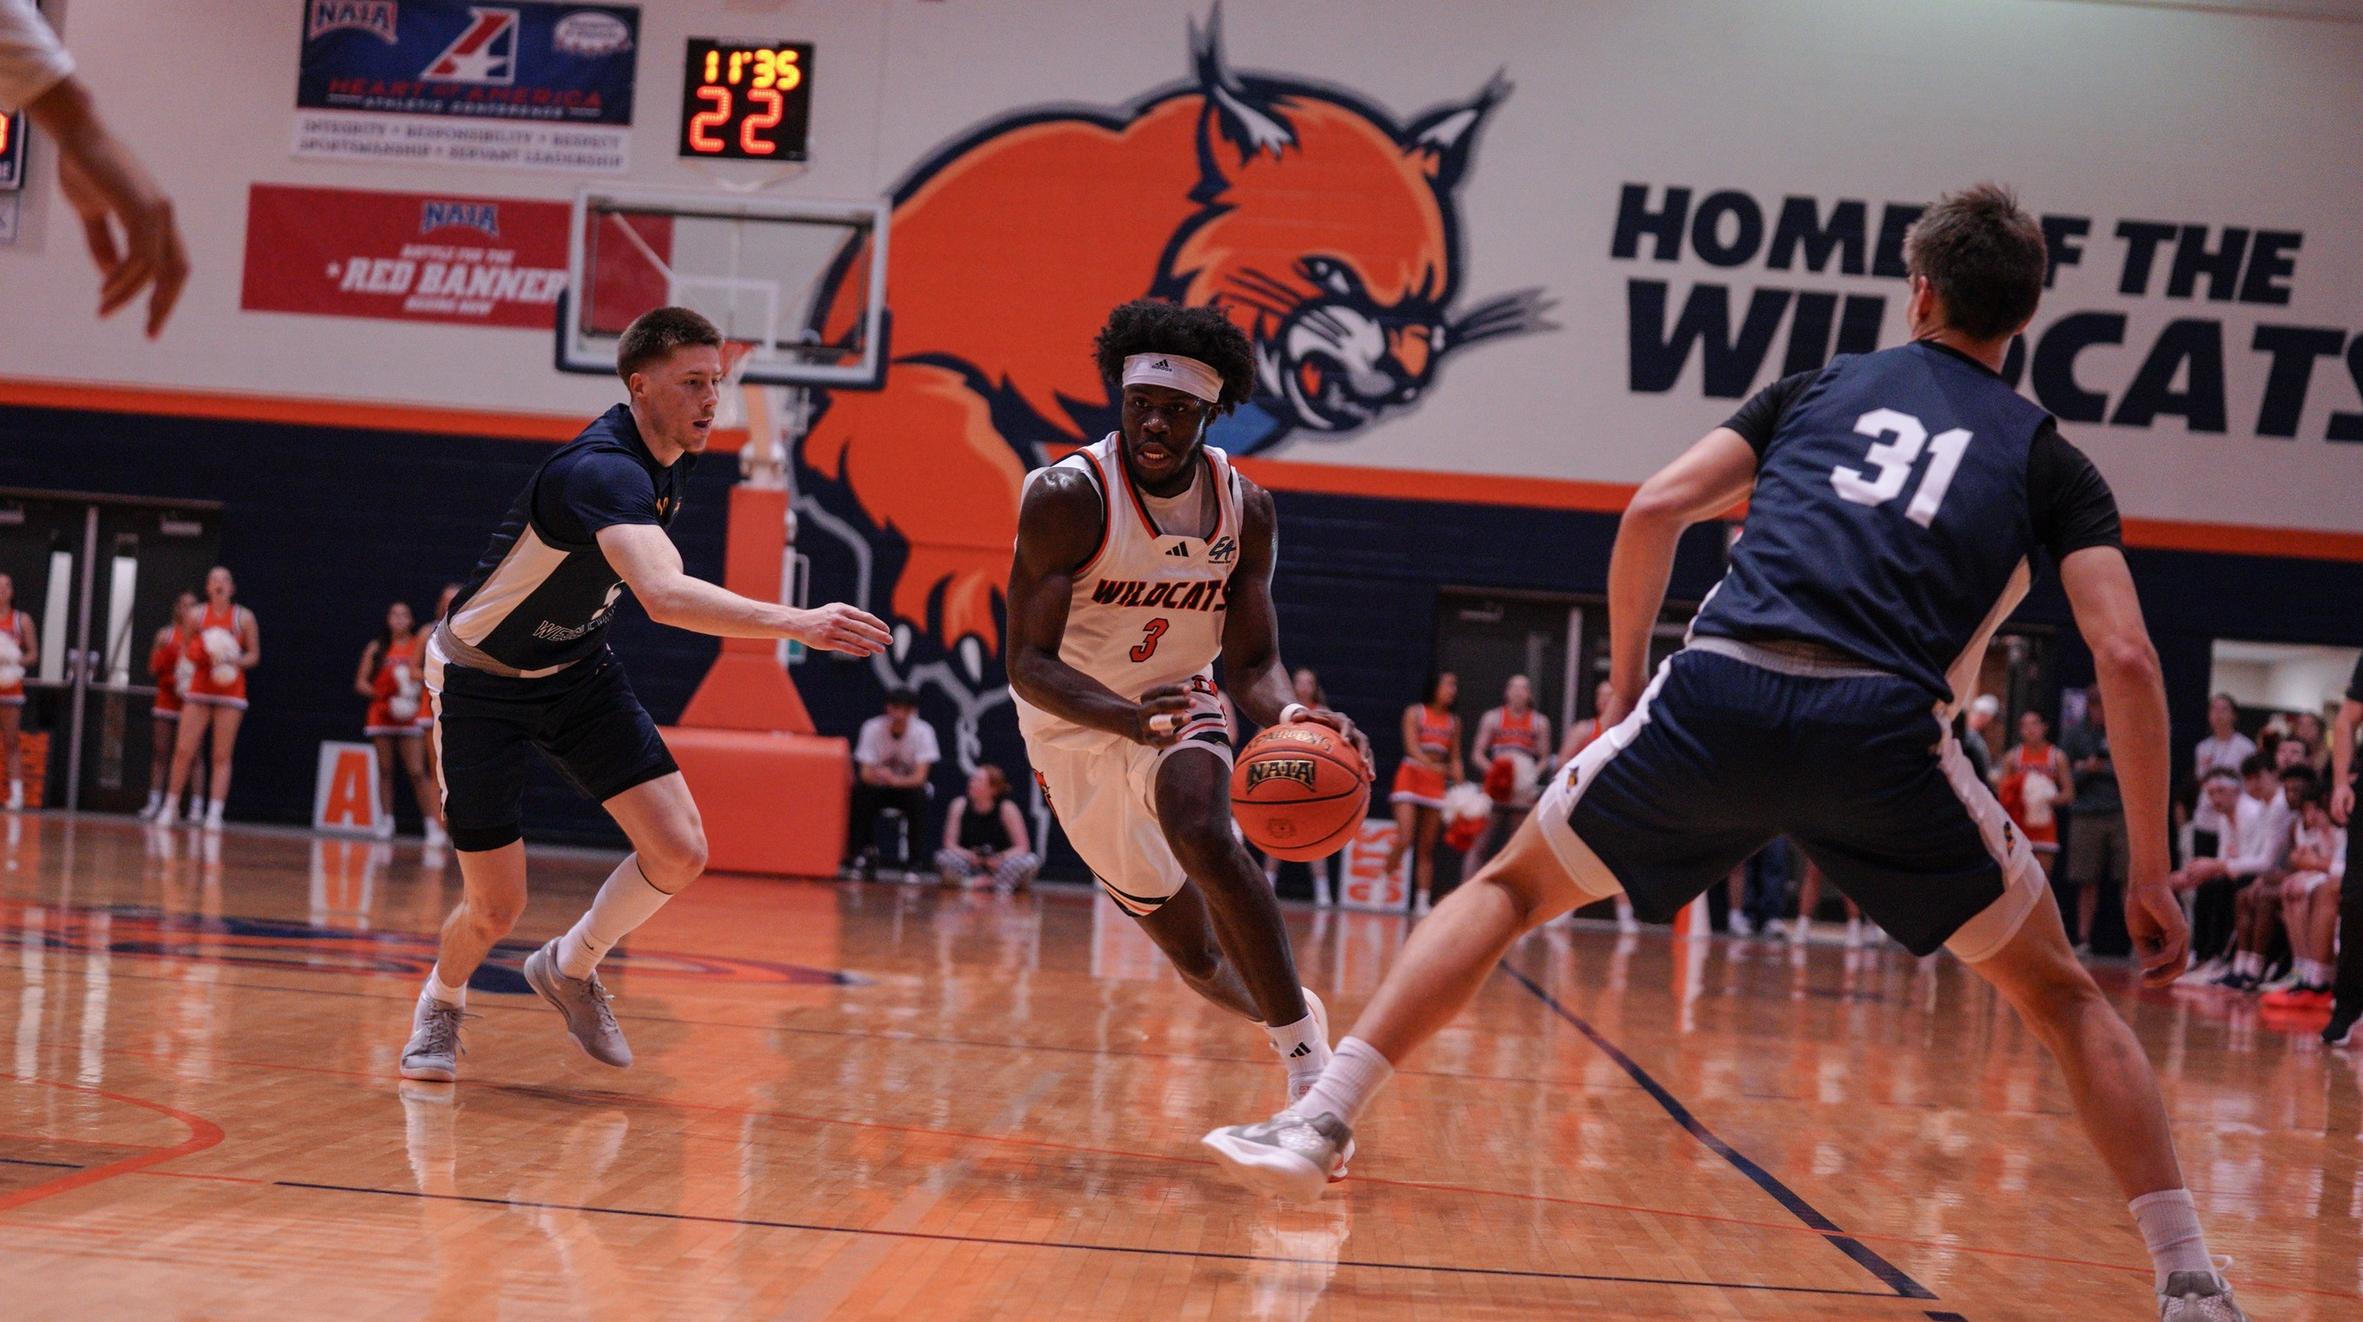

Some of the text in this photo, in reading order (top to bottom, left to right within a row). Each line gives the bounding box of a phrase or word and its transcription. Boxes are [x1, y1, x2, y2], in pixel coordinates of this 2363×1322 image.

[327, 78, 425, 97] HEART
[467, 87, 602, 109] AMERICA
[689, 86, 783, 154] 22
[420, 202, 499, 237] NAIA
[340, 257, 416, 294] RED
[2114, 219, 2304, 305] THE
[1627, 279, 2363, 443] WICAT
[1829, 407, 1974, 529] 31
[1129, 617, 1170, 663] 3
[324, 751, 373, 827] A
[1247, 760, 1316, 794] NAIA
